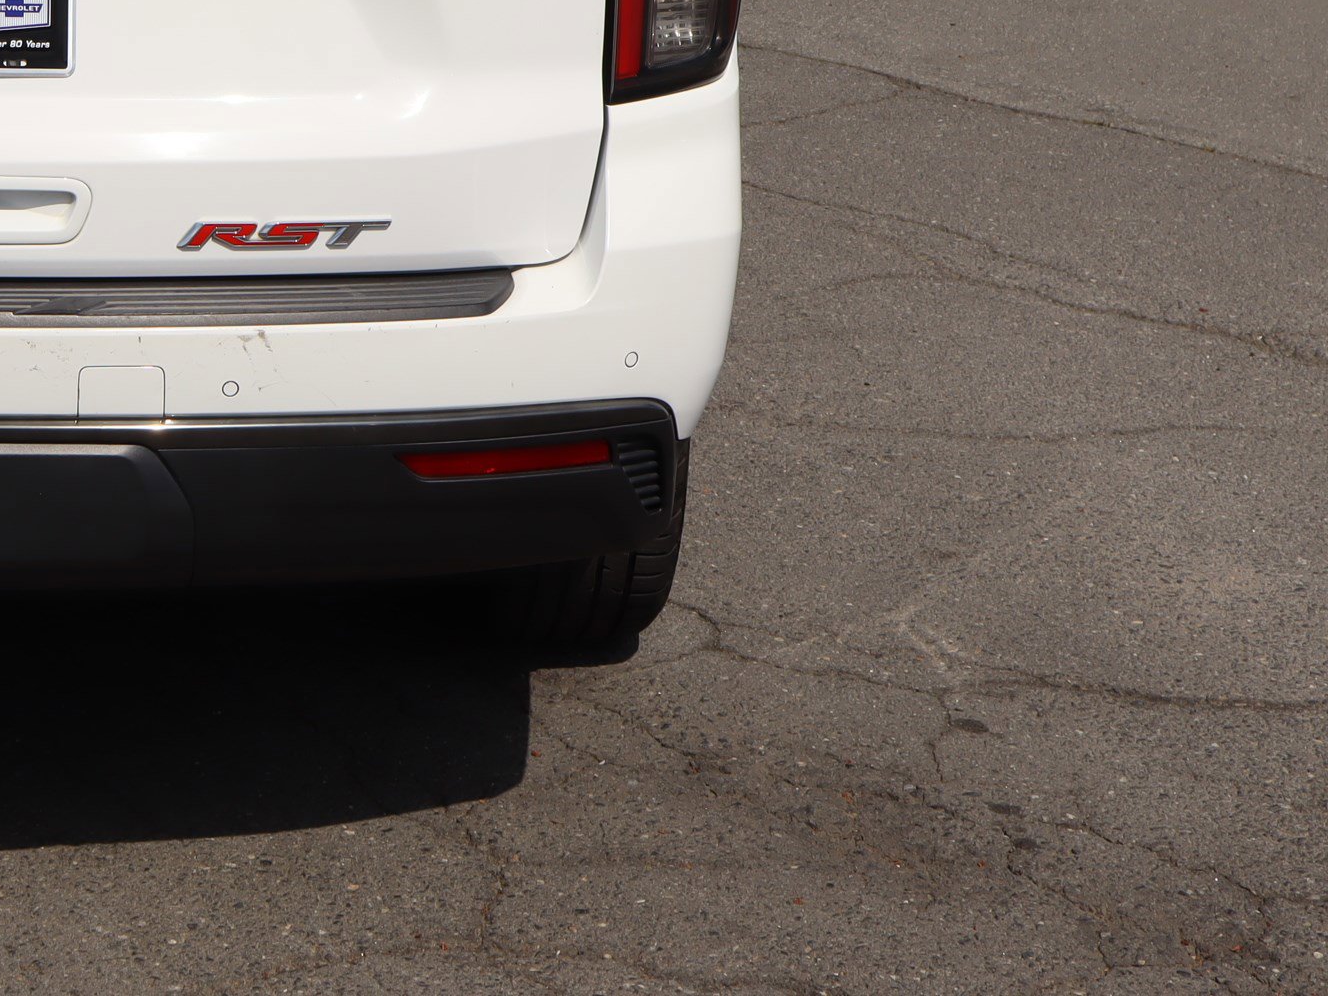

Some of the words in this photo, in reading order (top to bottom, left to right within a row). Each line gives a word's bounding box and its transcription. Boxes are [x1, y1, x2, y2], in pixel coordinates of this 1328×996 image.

[9, 39, 23, 48] 80
[26, 39, 50, 49] Years
[176, 219, 393, 251] RST
